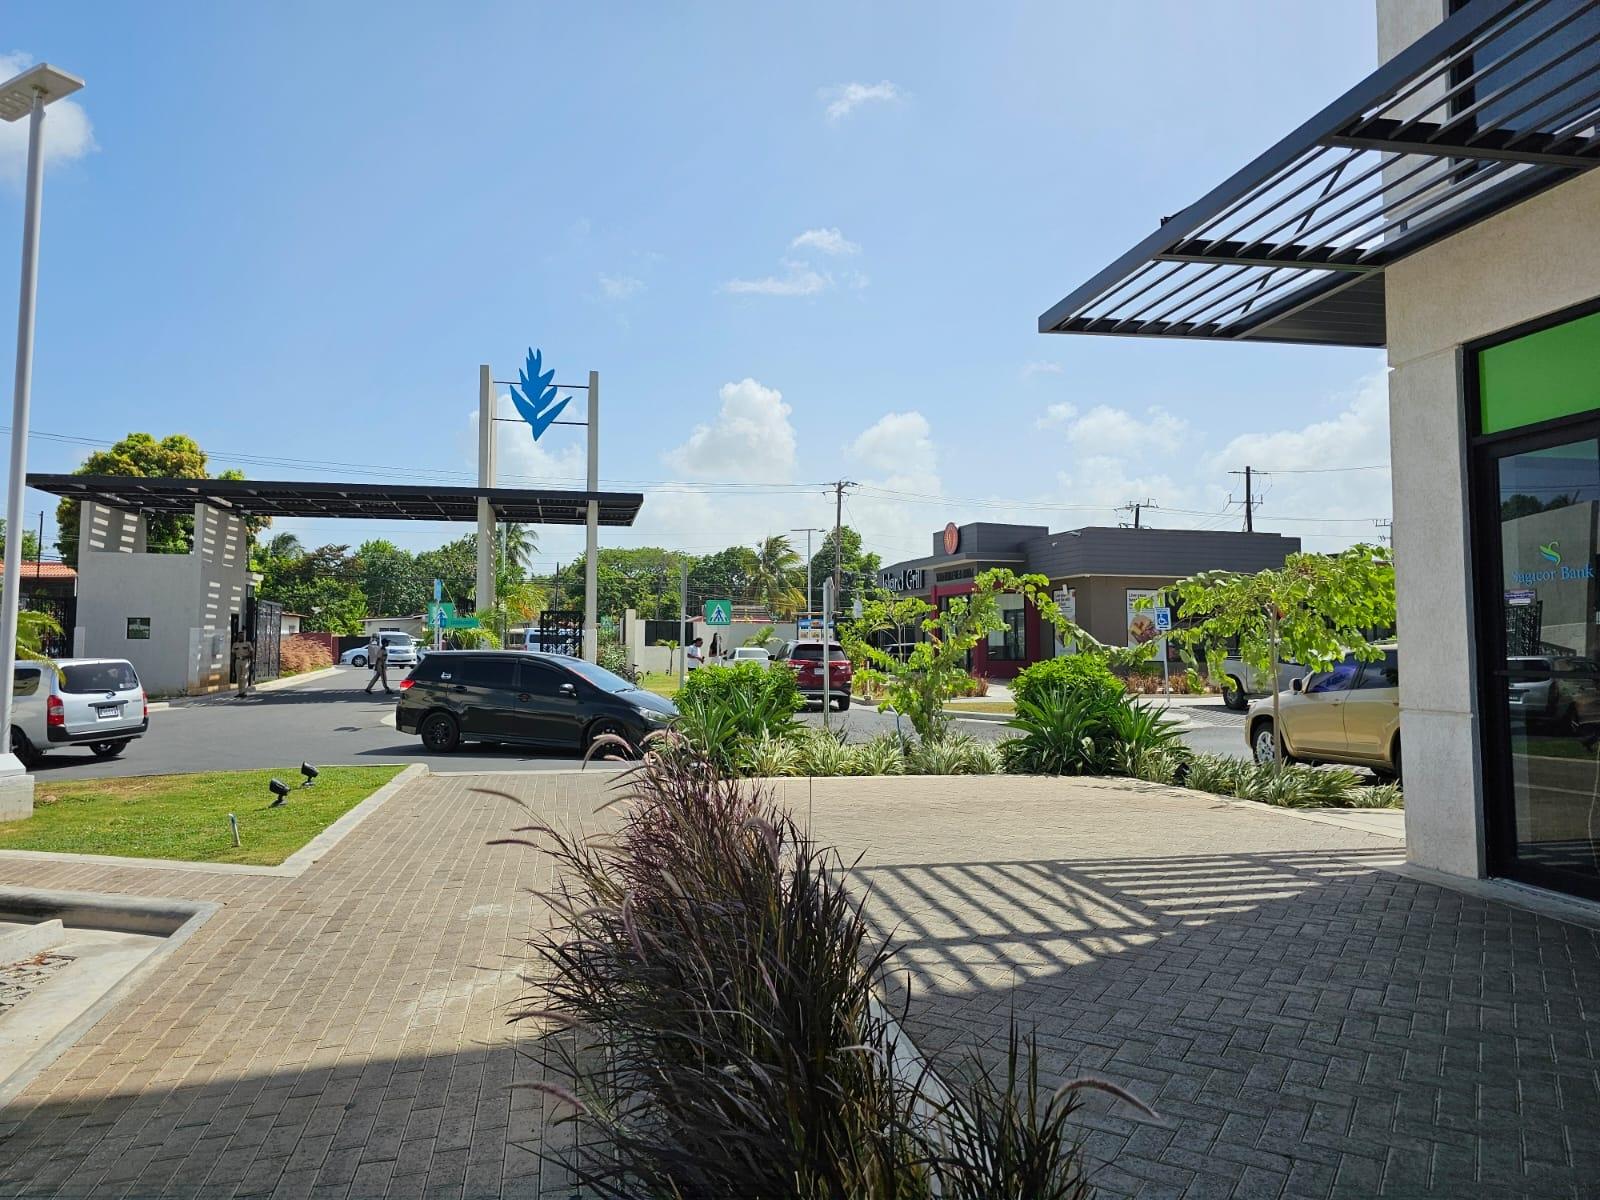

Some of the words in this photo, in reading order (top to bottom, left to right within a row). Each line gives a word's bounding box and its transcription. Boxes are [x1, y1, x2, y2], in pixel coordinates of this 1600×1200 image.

[882, 570, 904, 591] Island
[906, 568, 922, 590] Grill
[1511, 570, 1556, 586] Sagicor
[1560, 562, 1595, 580] Bank
